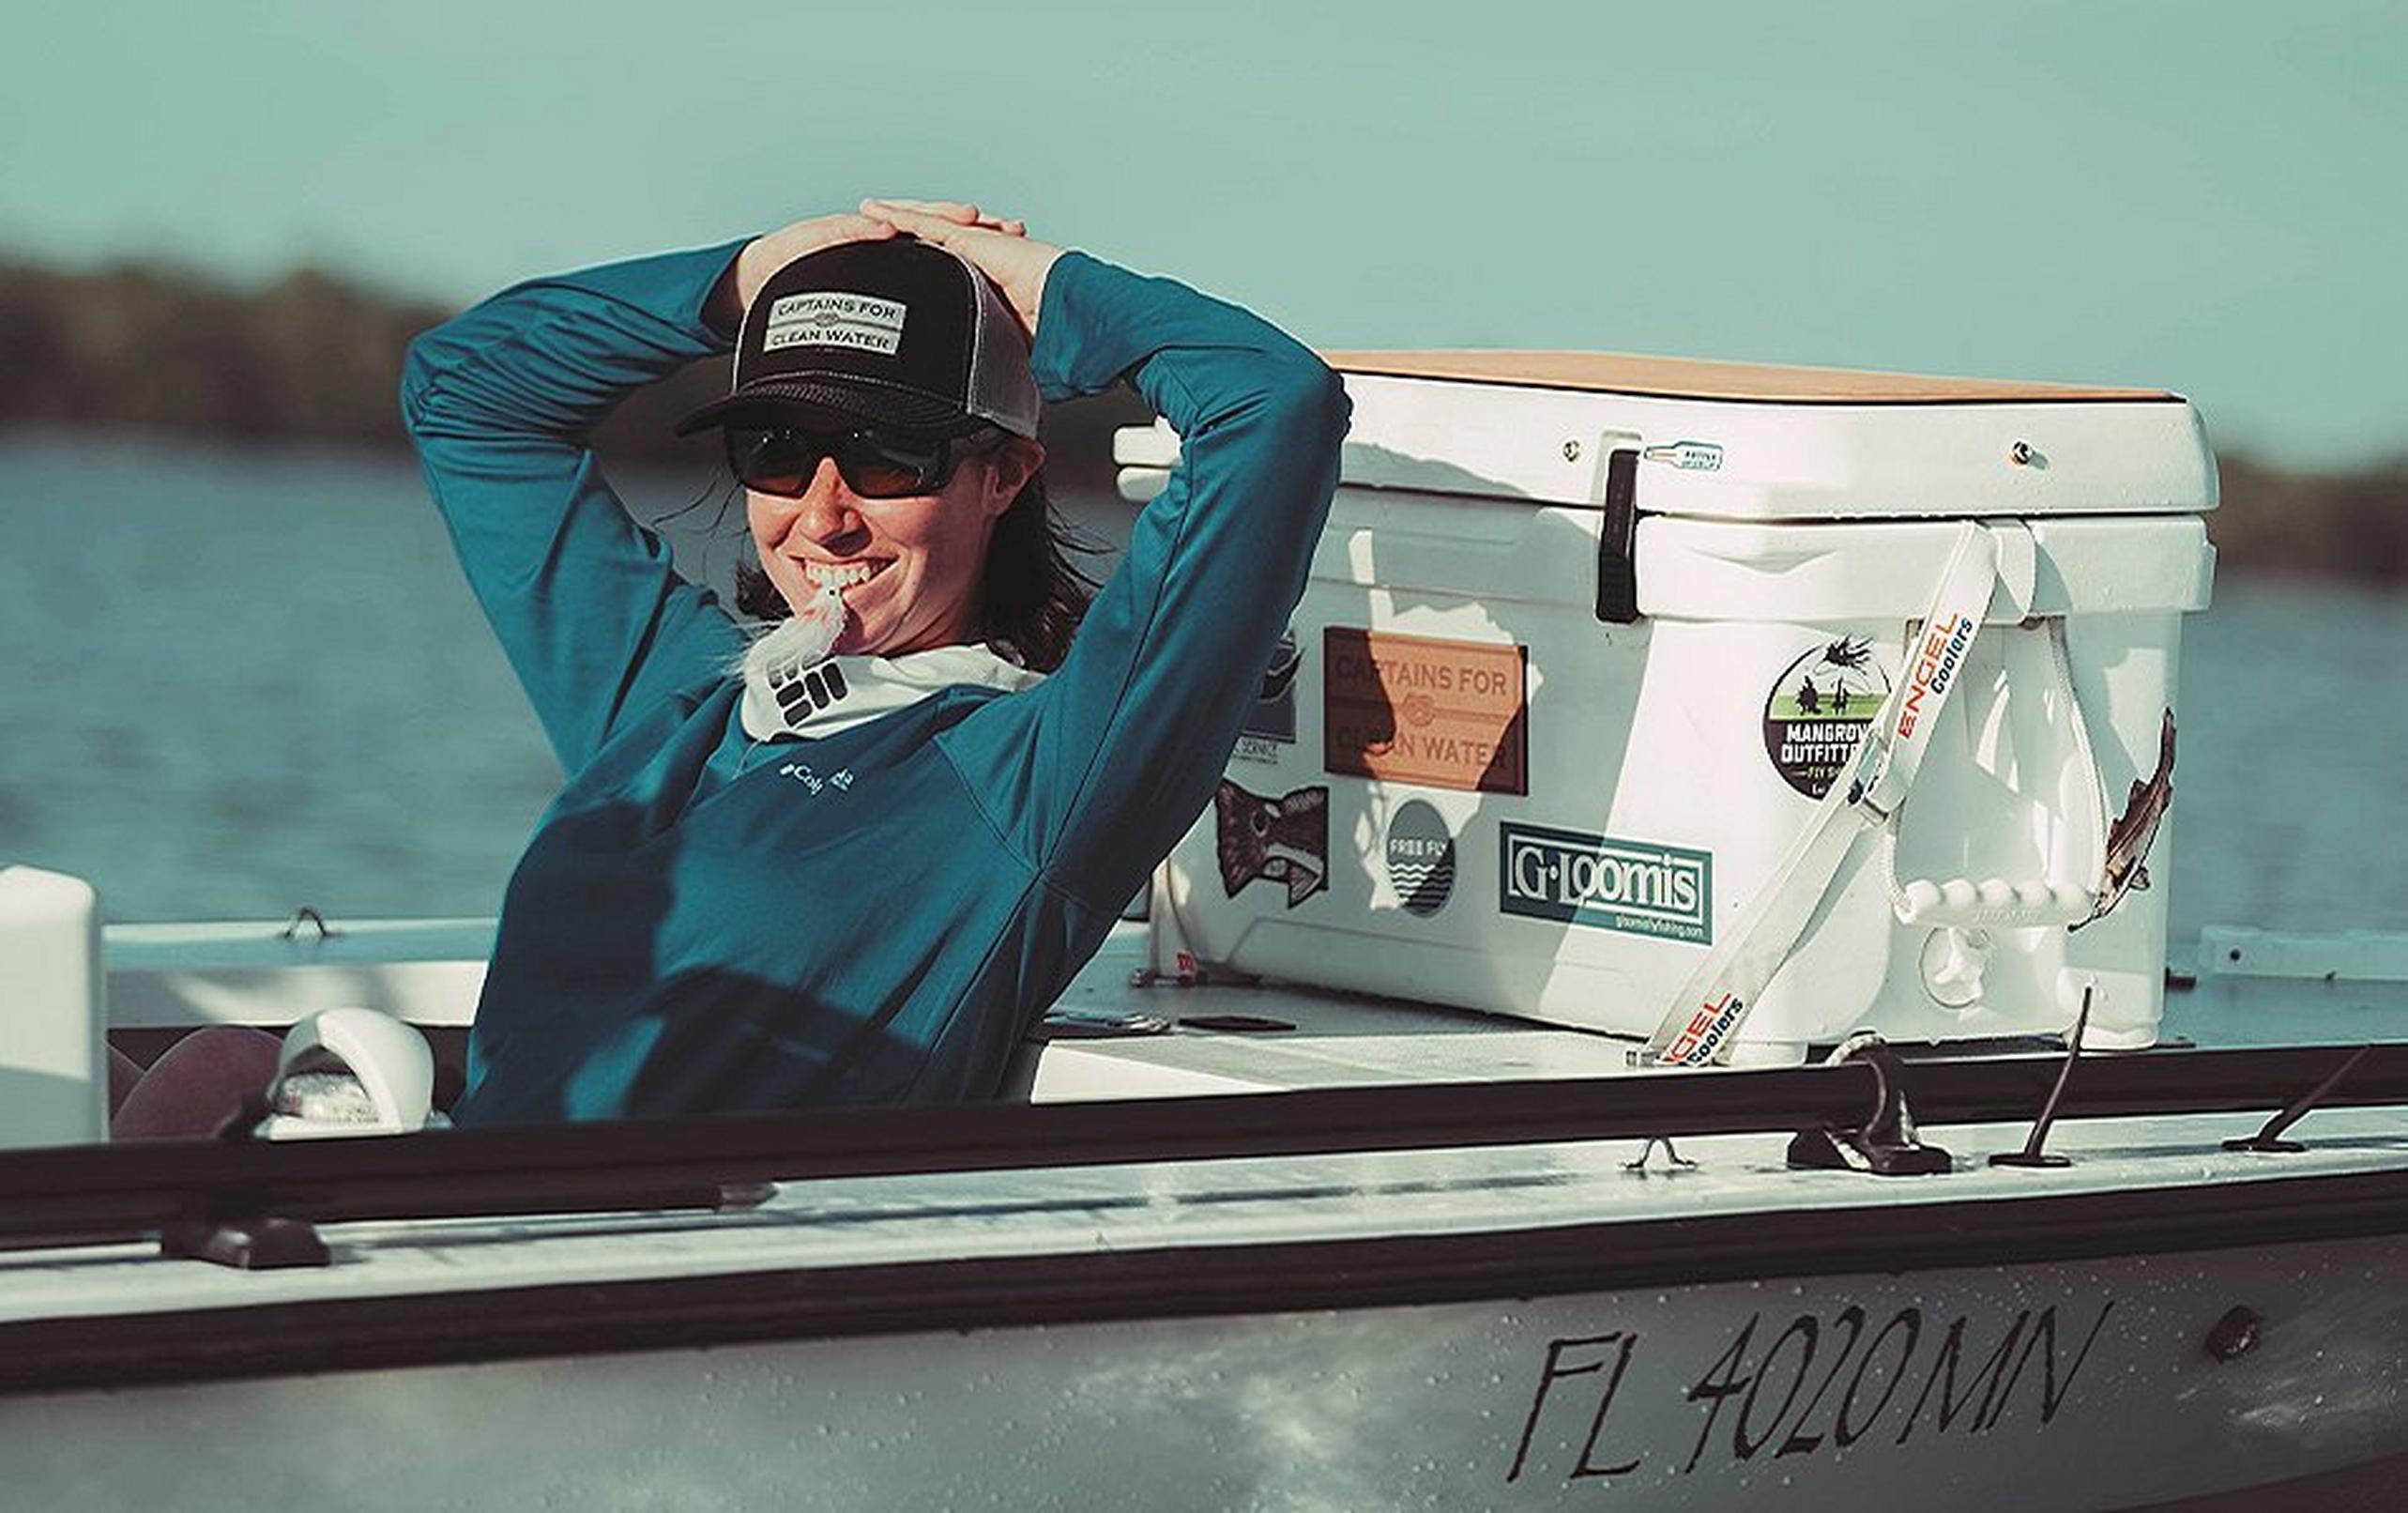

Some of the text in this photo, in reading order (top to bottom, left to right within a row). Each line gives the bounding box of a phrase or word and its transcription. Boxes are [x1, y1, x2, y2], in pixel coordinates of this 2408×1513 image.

[777, 298, 896, 319] CAPTAINS FOR
[771, 329, 891, 349] CLEAN WATER
[1929, 617, 1974, 695] Coolers
[1459, 668, 1507, 696] FOR
[1897, 612, 1959, 740] ENGEL
[1786, 723, 1867, 743] MANGROV
[1423, 735, 1508, 768] WATER
[1781, 743, 1852, 764] OUTFITT
[1389, 838, 1447, 857] FREE FLY
[1669, 993, 1730, 1061] GEL
[1505, 1330, 1641, 1483] FL
